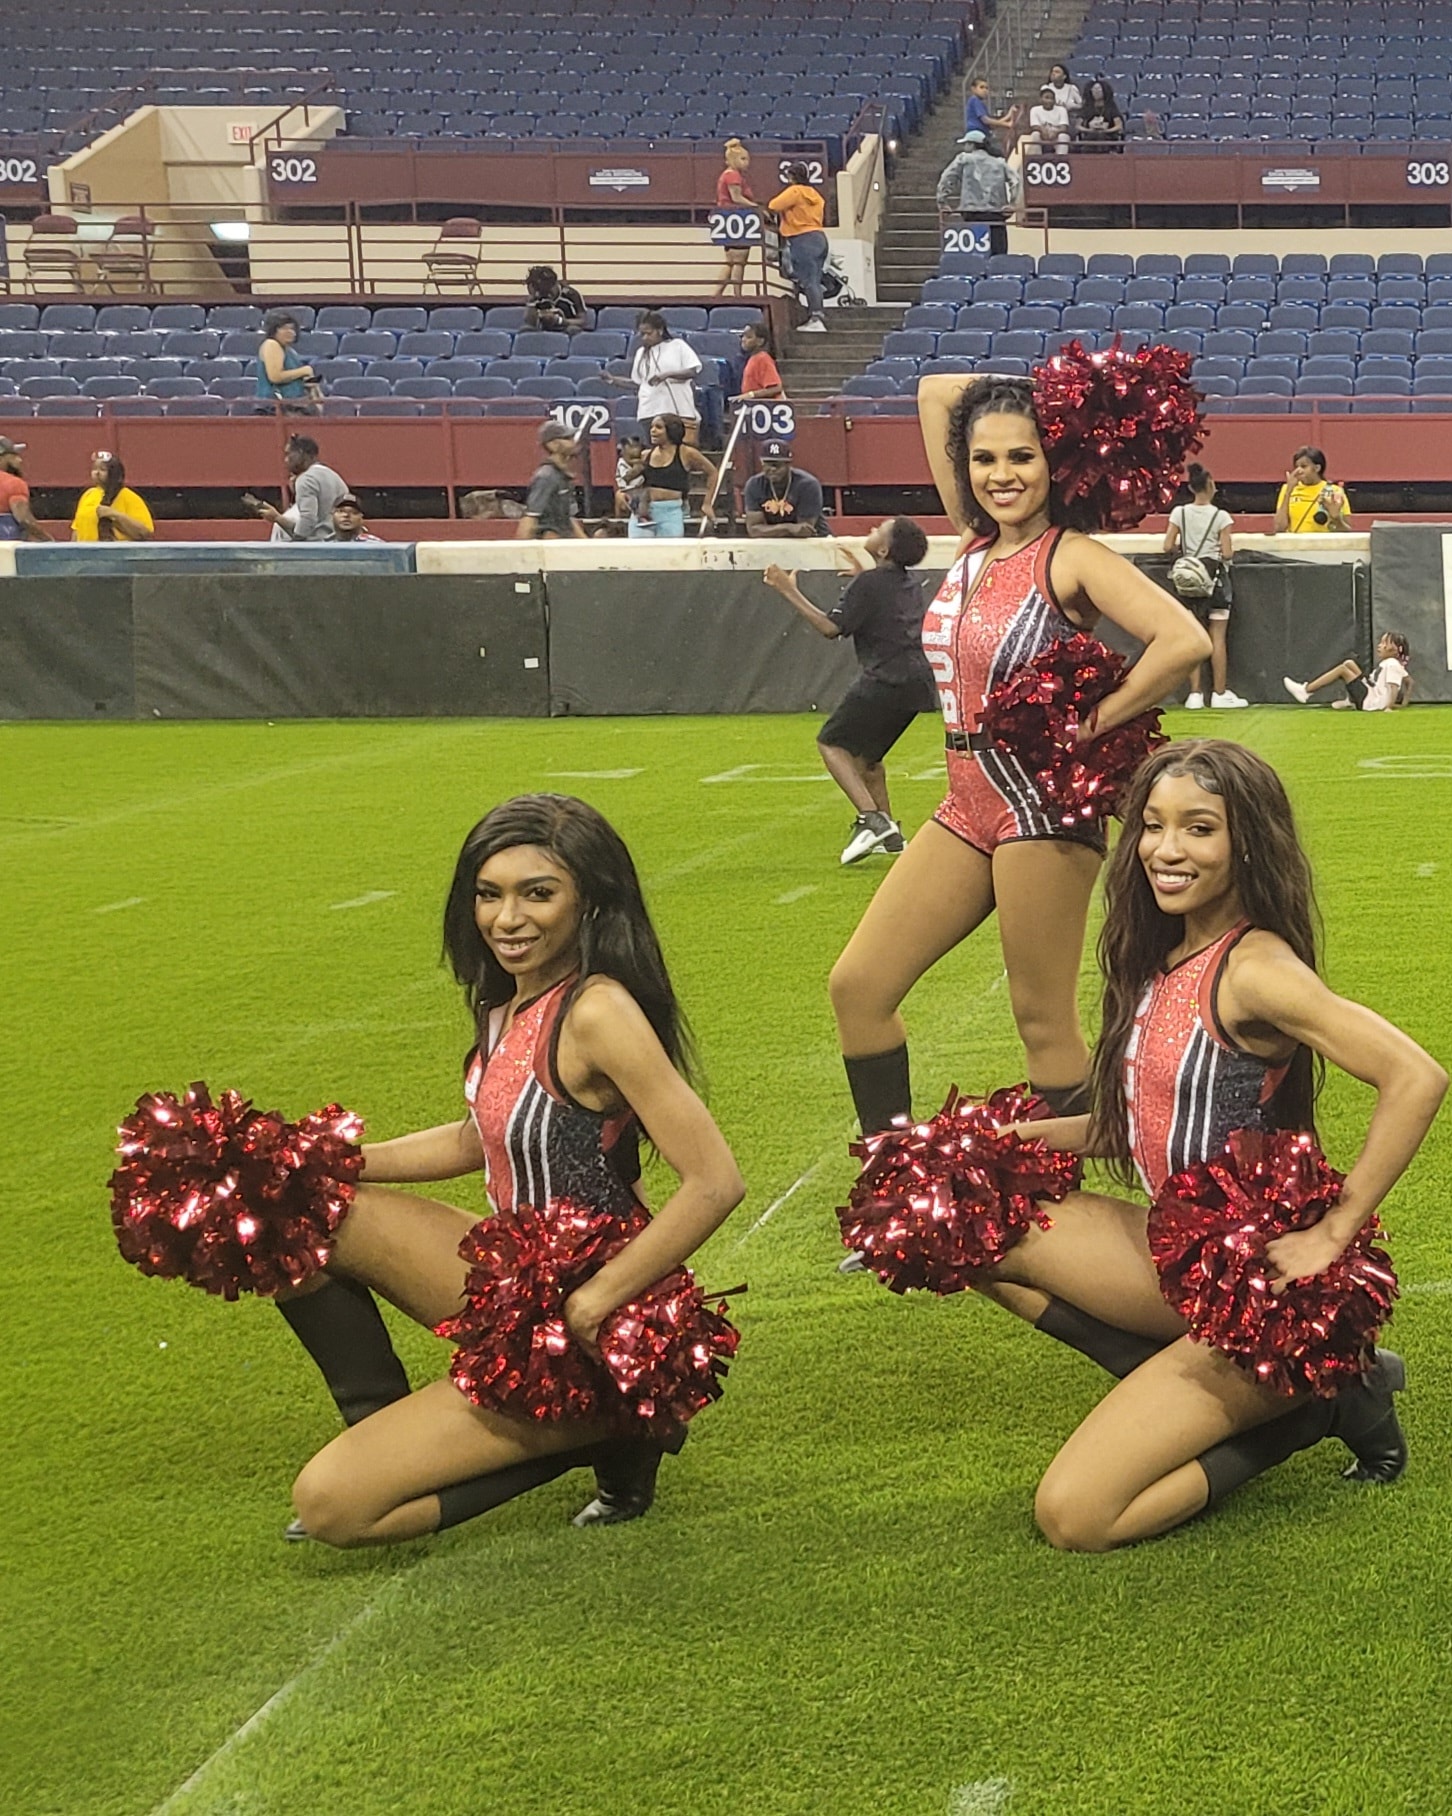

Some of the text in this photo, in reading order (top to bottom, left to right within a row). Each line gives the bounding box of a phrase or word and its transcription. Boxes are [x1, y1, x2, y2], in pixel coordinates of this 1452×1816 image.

[271, 159, 317, 182] 302
[1027, 162, 1071, 184] 303
[1407, 162, 1449, 184] 303
[709, 214, 762, 239] 202
[734, 404, 795, 434] 103
